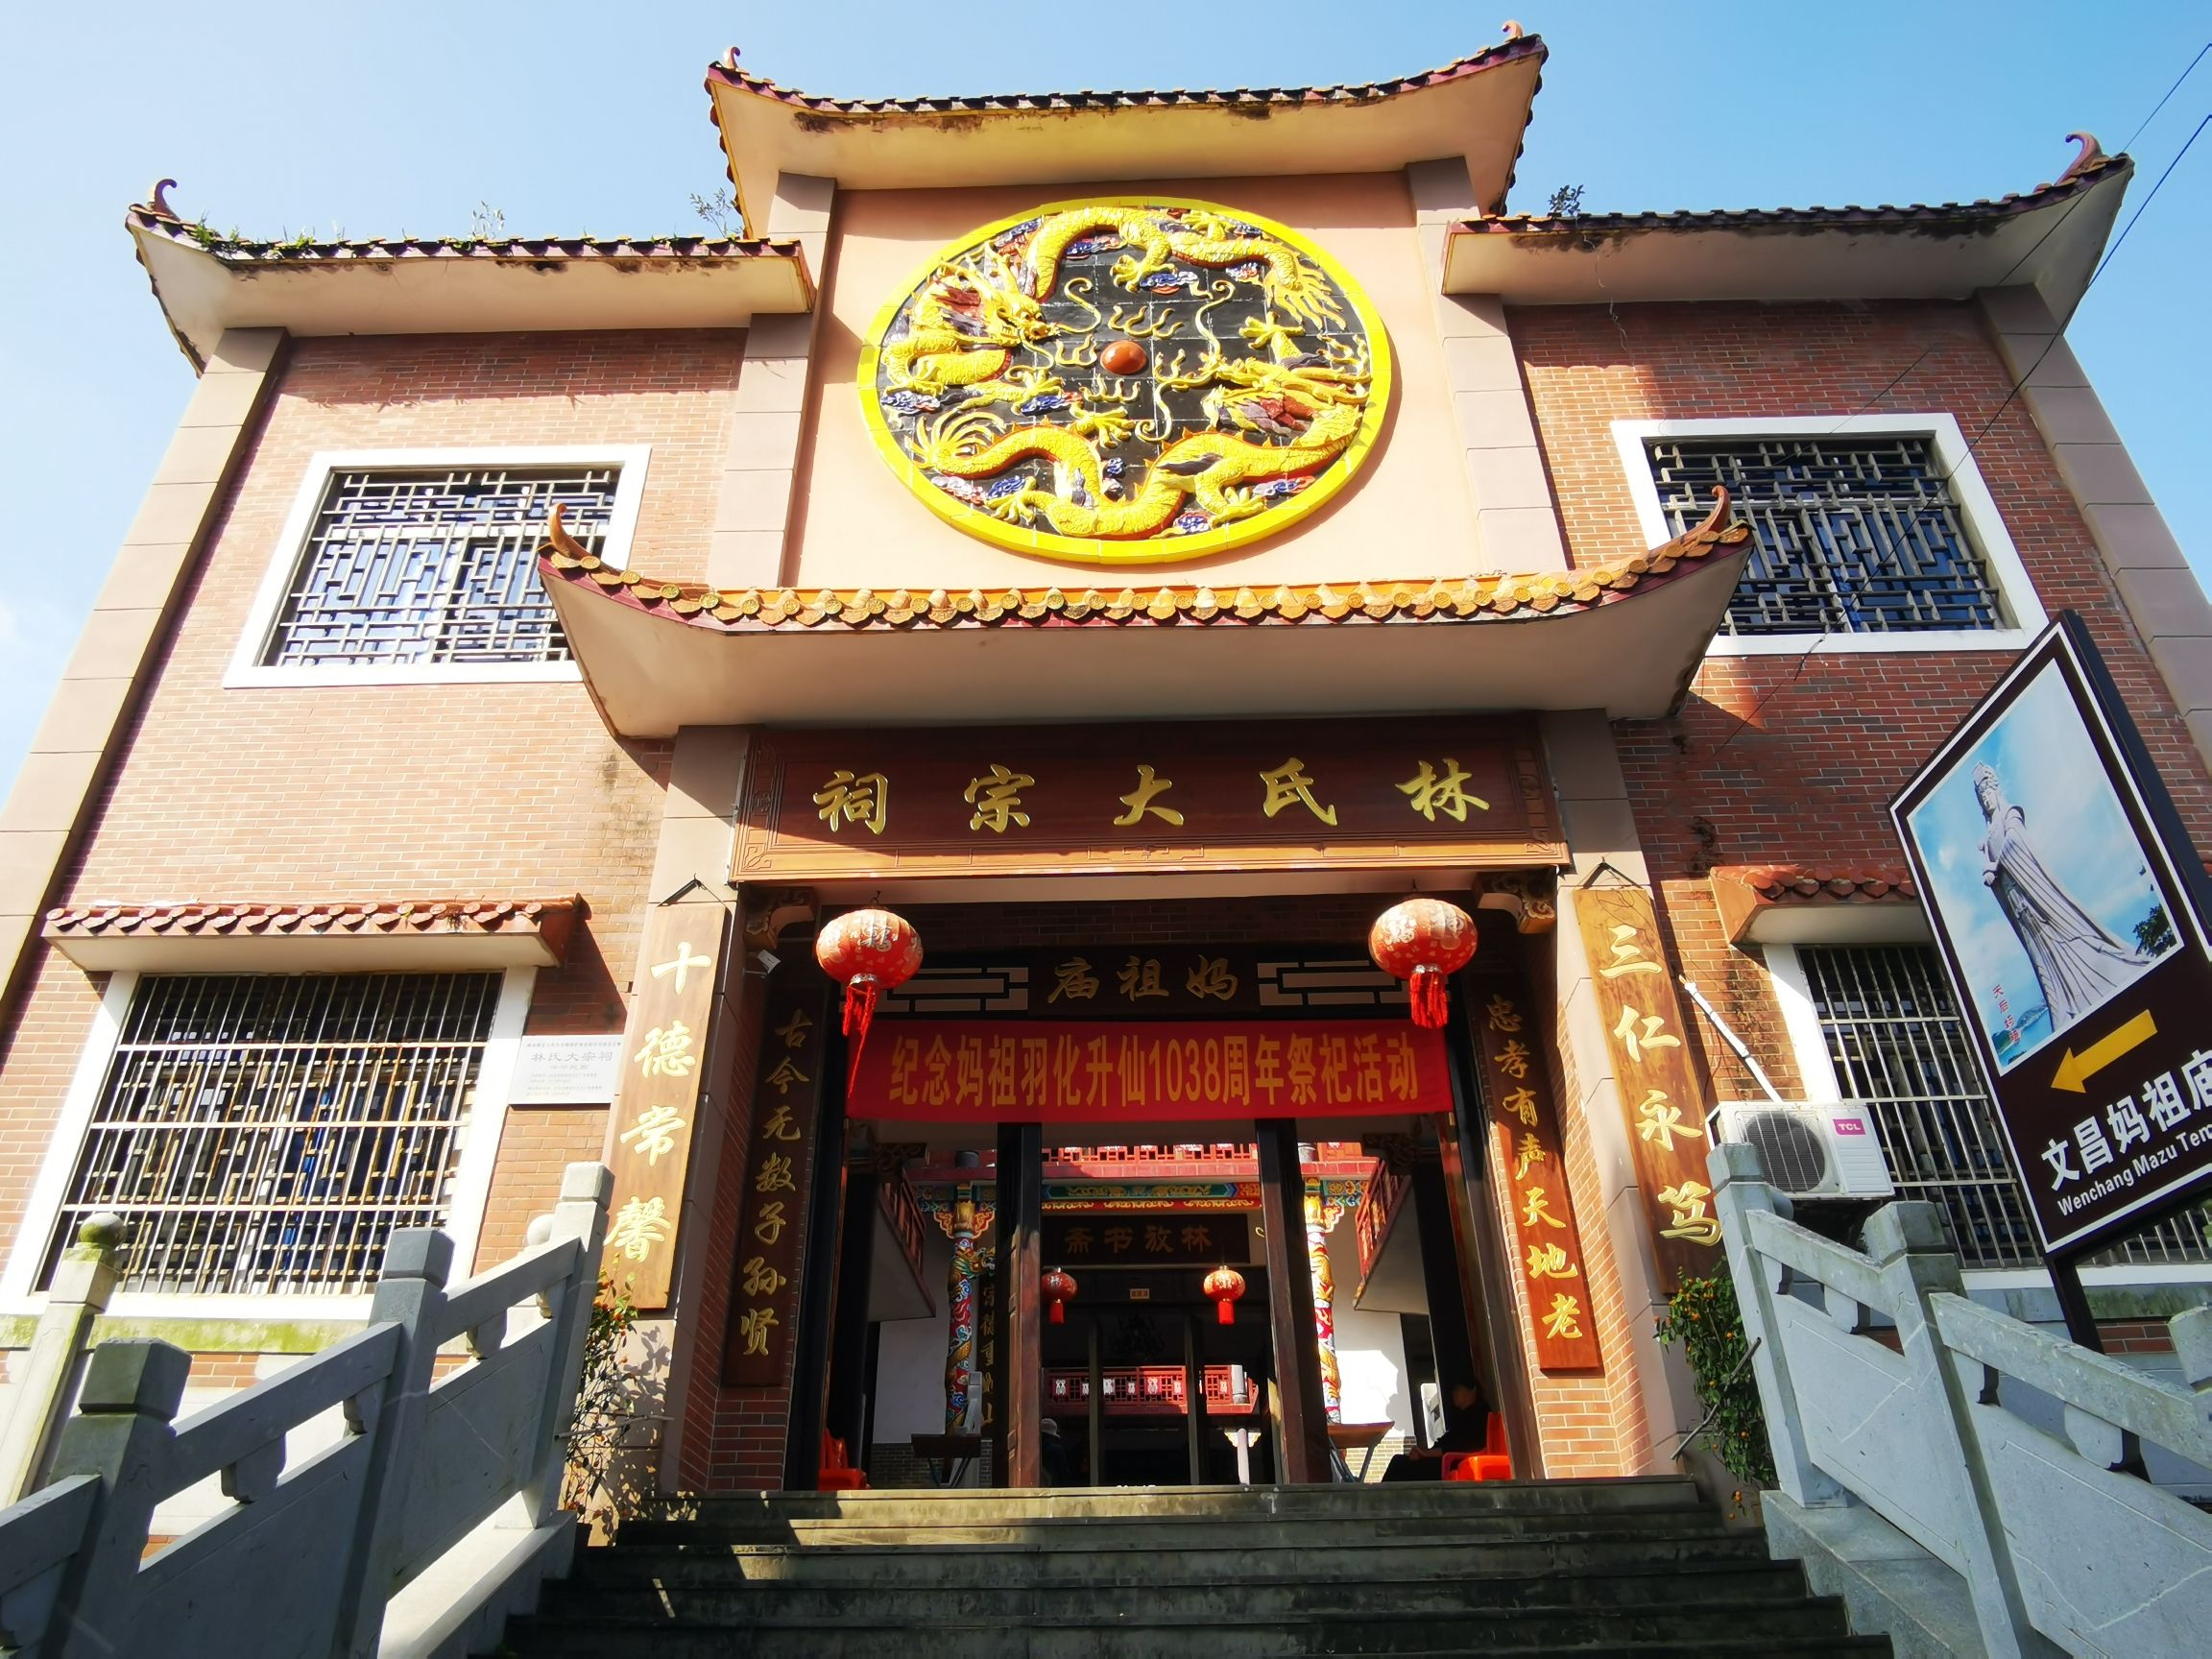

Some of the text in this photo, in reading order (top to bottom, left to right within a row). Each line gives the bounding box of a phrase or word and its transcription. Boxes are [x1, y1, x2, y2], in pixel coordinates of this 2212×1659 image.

[604, 941, 711, 1262] 十德常馨
[888, 1031, 1419, 1107] 纪念妈祖羽化升仙1038周年祭祀活动
[1485, 994, 1583, 1339] 忠孝有声天地老
[1838, 1122, 1862, 1132] TCL
[740, 1008, 814, 1356] 古今无数子孙贤
[2057, 1168, 2134, 1216] Wenchang
[2132, 1145, 2177, 1177] Mazu
